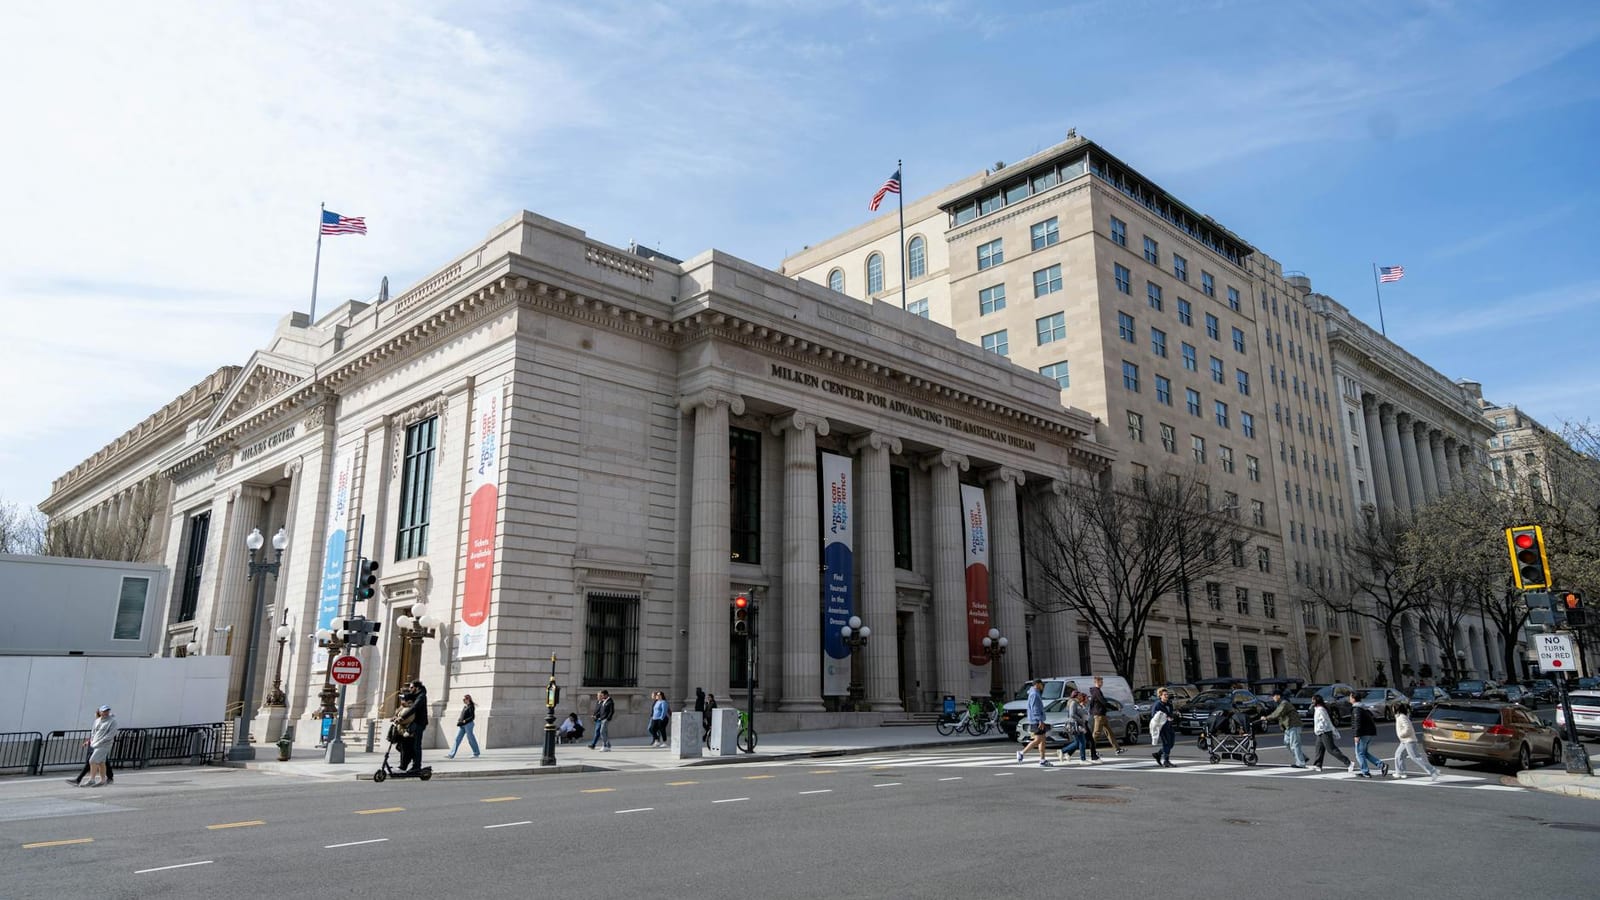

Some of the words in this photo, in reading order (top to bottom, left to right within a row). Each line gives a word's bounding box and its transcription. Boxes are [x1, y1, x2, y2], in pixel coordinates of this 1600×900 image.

[771, 364, 819, 388] MILKEN
[822, 379, 864, 402] CENTER
[867, 392, 887, 409] FOR
[889, 400, 942, 425] ADVANCING
[944, 416, 962, 432] THE
[963, 422, 1007, 443] AMERICAN
[1008, 435, 1036, 452] DREAM
[478, 413, 487, 476] American
[484, 416, 492, 461] Dream
[830, 481, 838, 534] American
[840, 472, 848, 531] Experience
[1544, 636, 1560, 644] NO
